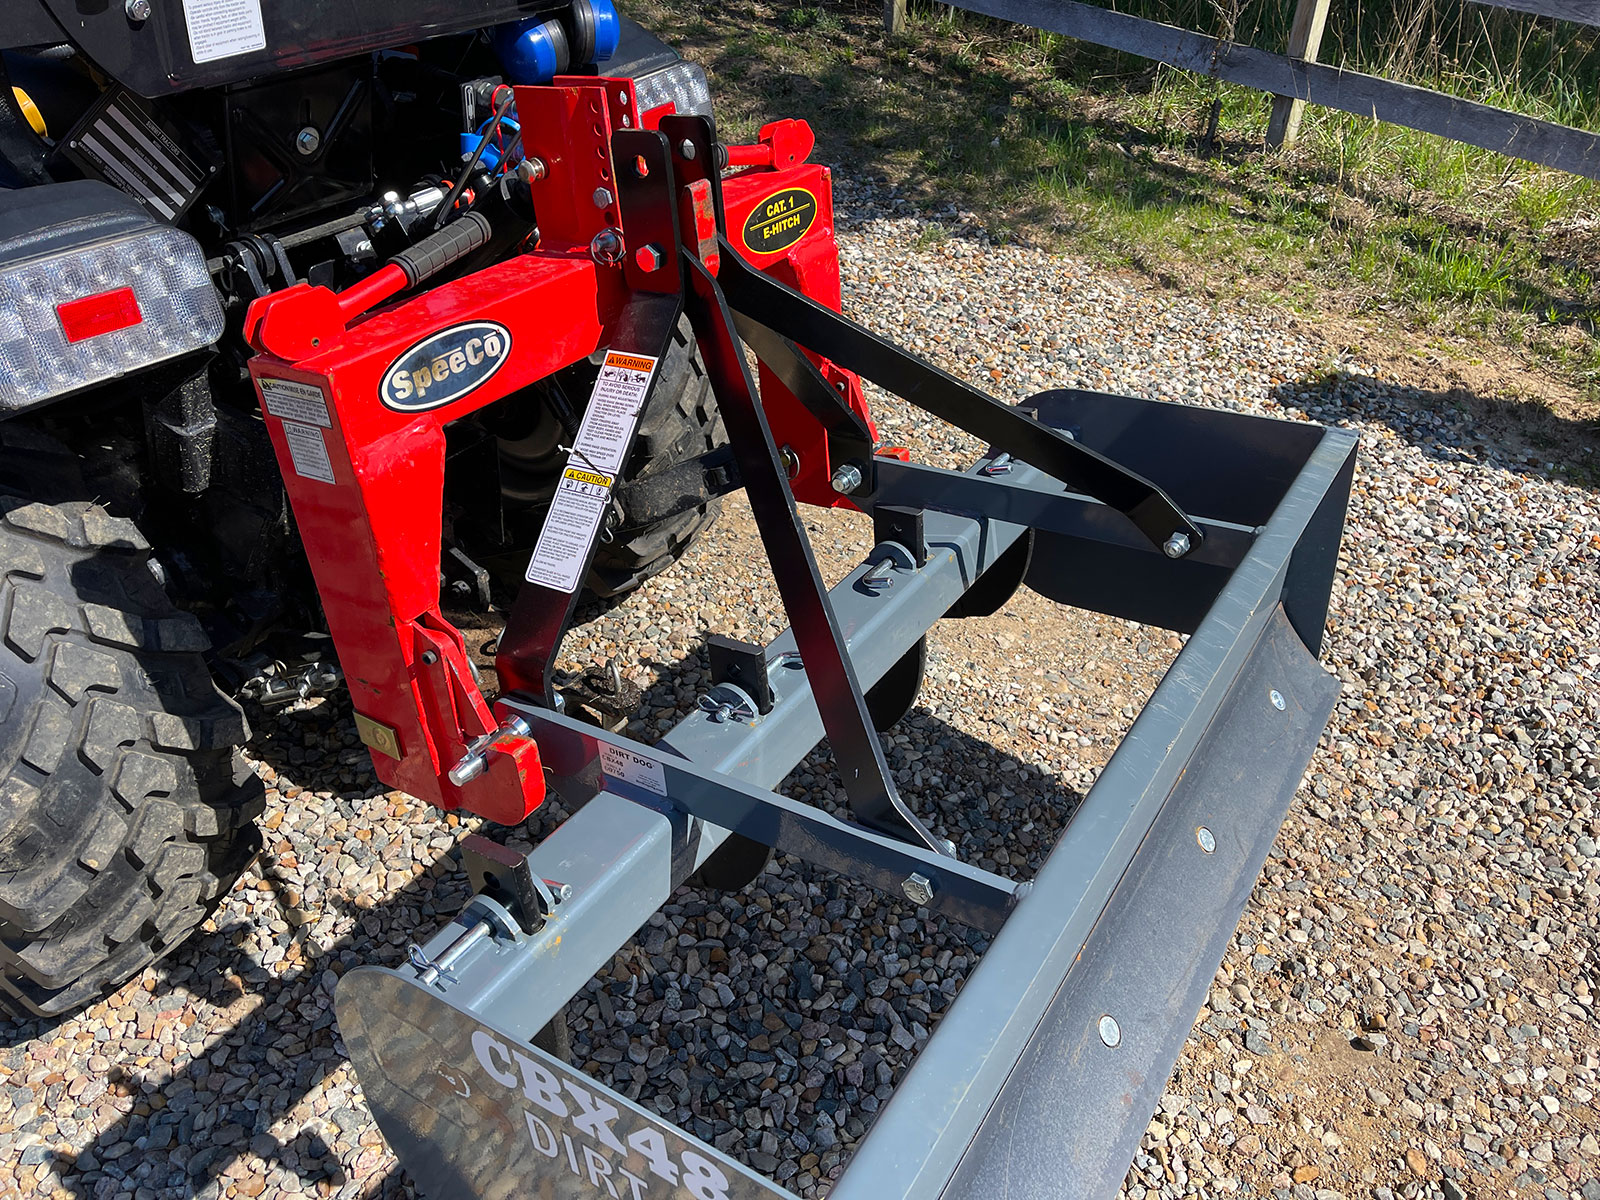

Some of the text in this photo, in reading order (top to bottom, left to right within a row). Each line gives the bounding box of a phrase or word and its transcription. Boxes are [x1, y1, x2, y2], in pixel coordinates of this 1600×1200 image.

[160, 134, 180, 155] TRACTORS
[766, 196, 794, 217] CAT. 1
[763, 213, 801, 239] E-HITCH
[615, 357, 652, 370] WARNING
[293, 428, 320, 438] WARNING
[576, 472, 608, 485] CAUTION
[601, 754, 624, 767] CBX48
[609, 747, 630, 760] DIRT
[632, 756, 654, 769] DOG
[471, 1030, 729, 1200] CBX48
[524, 1109, 649, 1200] DIRT
